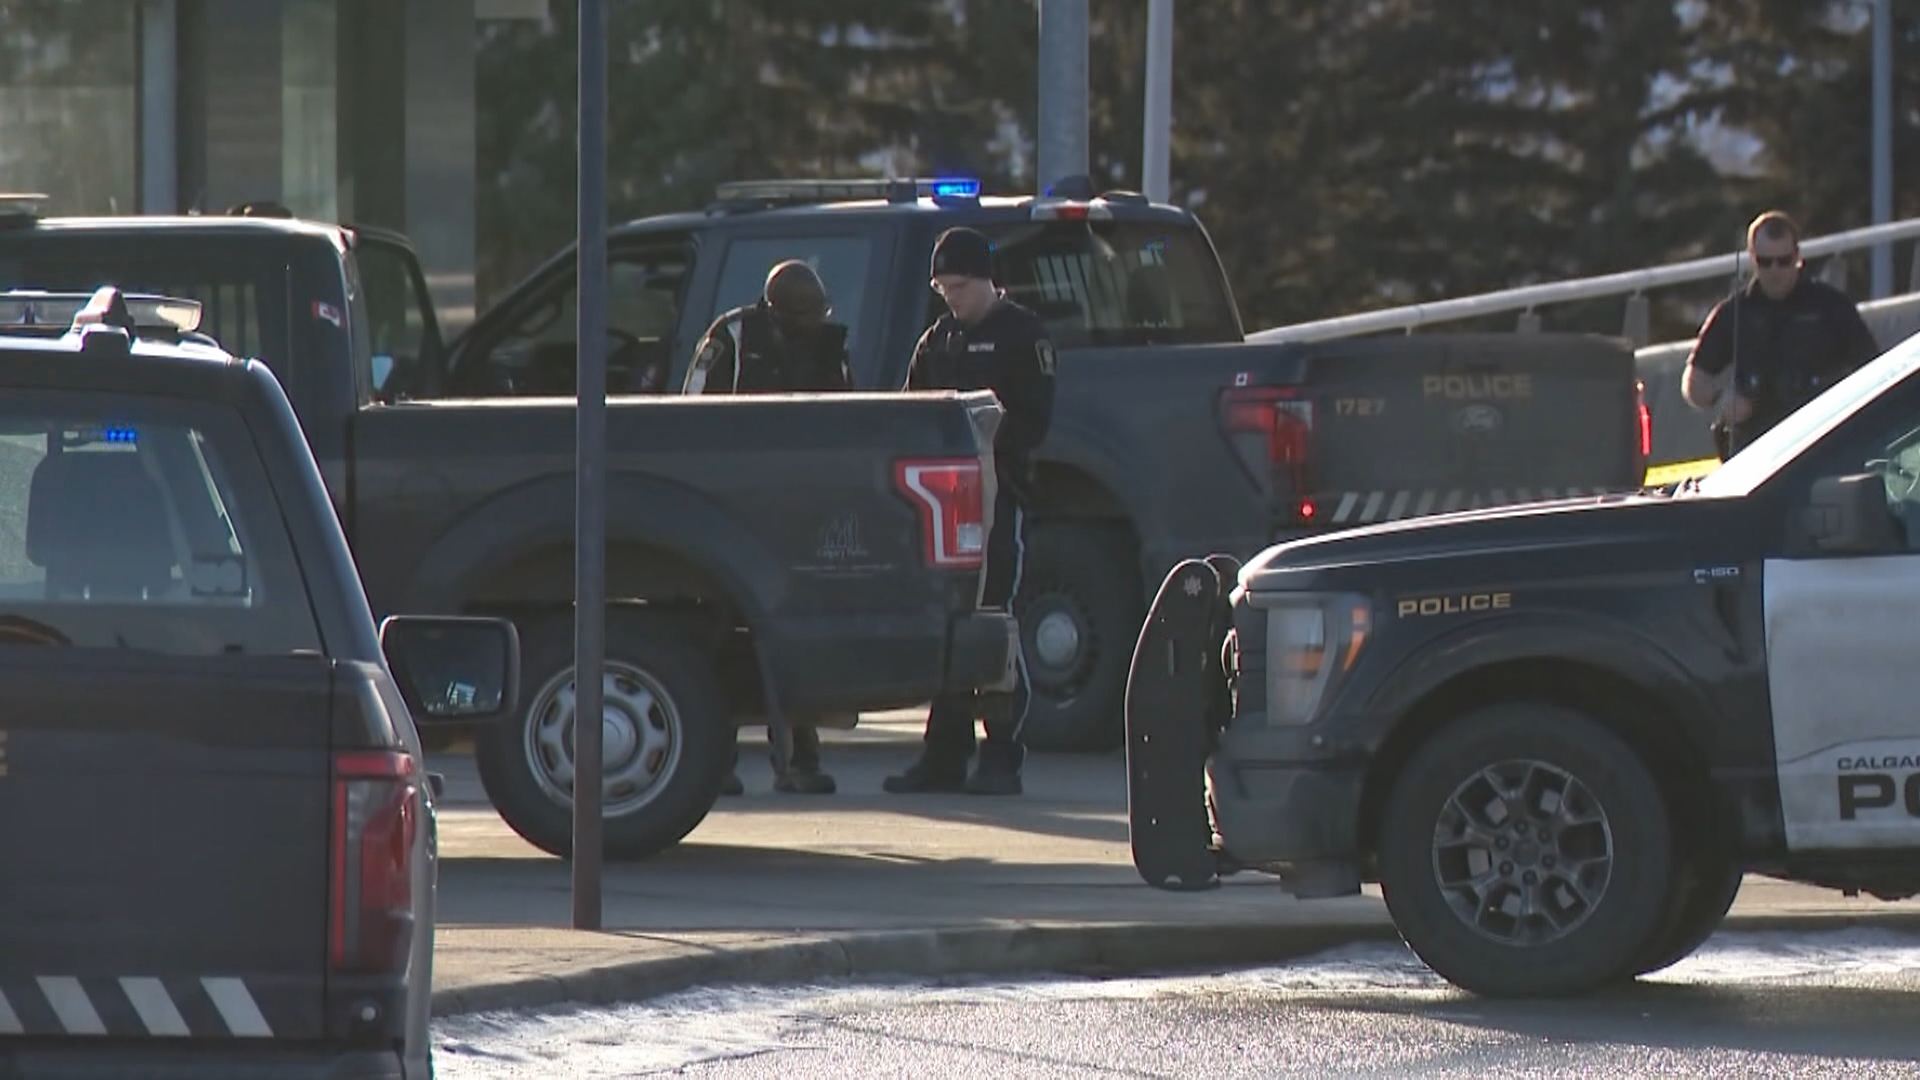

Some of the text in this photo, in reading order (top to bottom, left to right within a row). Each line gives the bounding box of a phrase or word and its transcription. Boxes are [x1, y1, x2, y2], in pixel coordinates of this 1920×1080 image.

[1422, 374, 1533, 399] POLICE
[1398, 593, 1511, 618] POLICE
[1838, 773, 1920, 821] P
